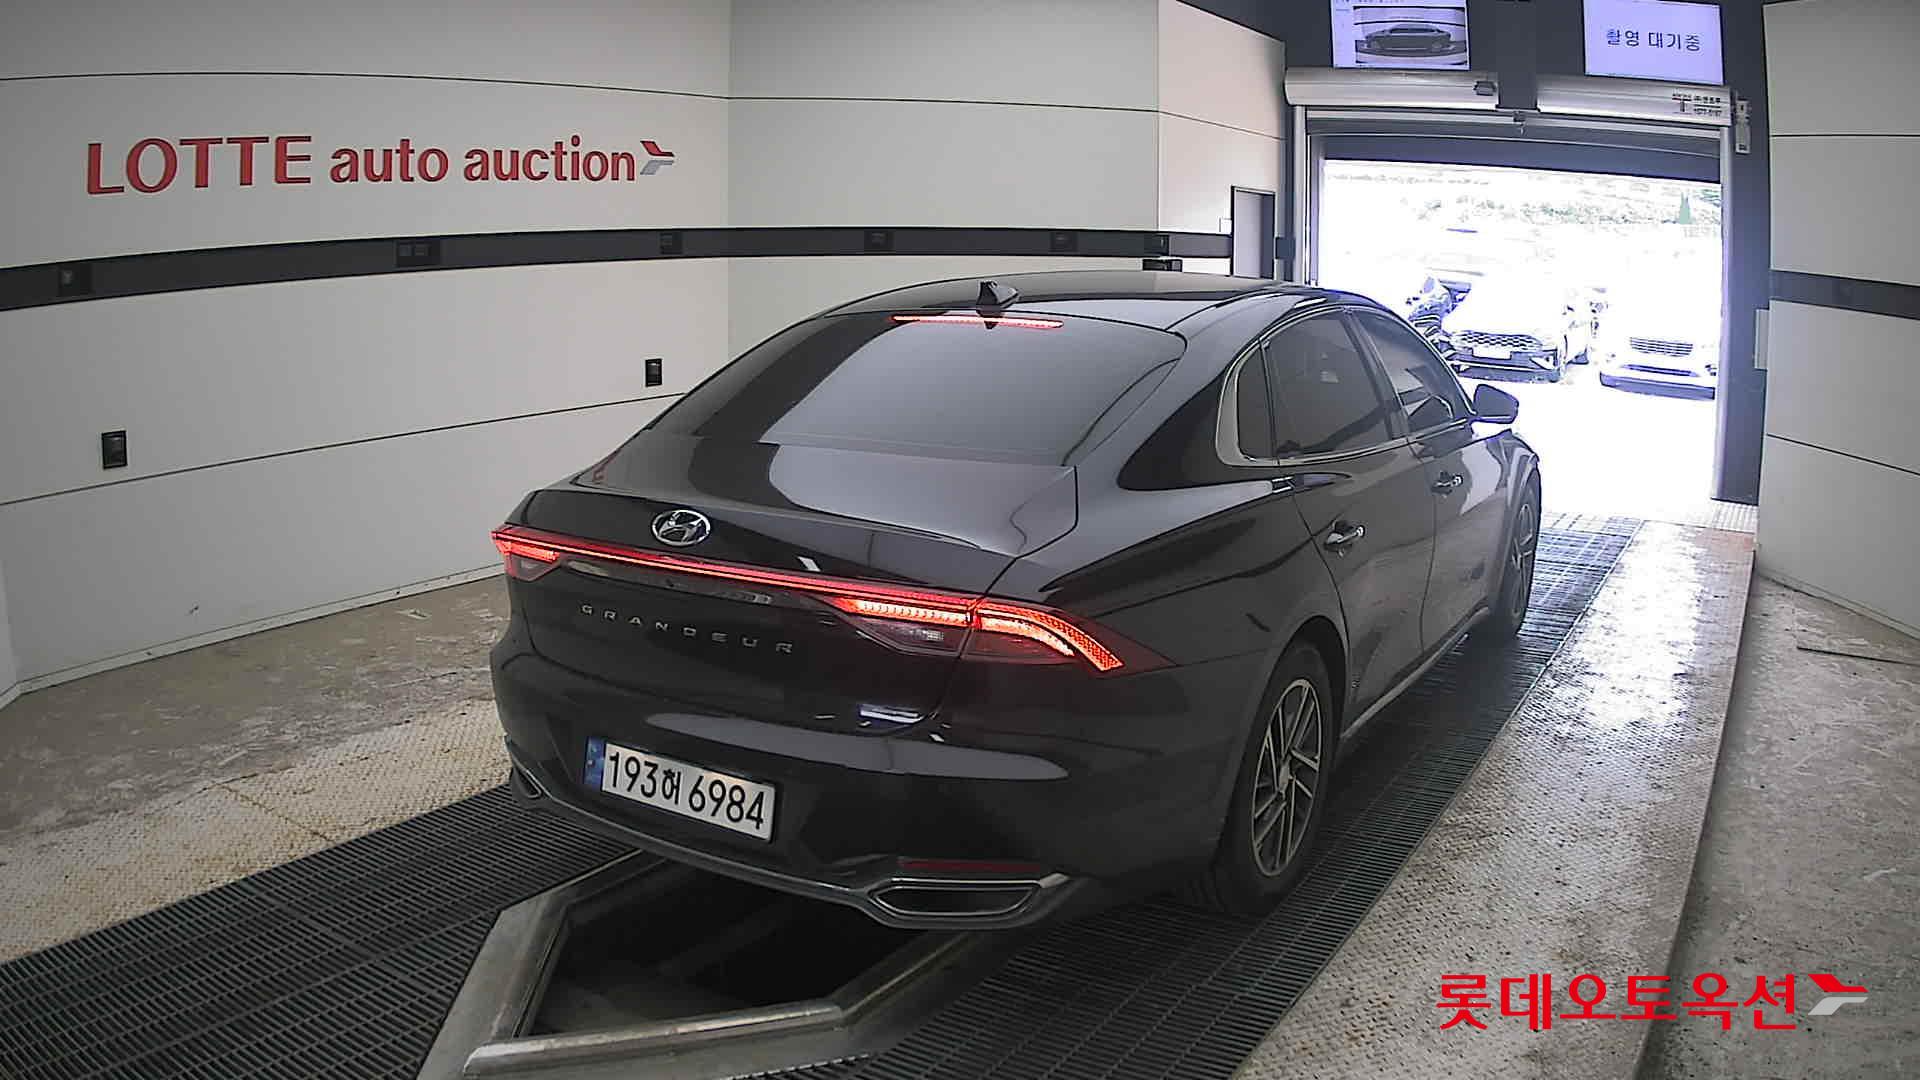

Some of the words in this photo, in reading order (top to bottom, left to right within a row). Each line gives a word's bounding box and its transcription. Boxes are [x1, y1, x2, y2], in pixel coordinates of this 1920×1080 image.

[1648, 32, 1700, 52] 대기중
[86, 135, 312, 195] LOTTE
[330, 137, 449, 183] auto
[463, 134, 636, 183] auction
[581, 603, 793, 653] GRANDEUR
